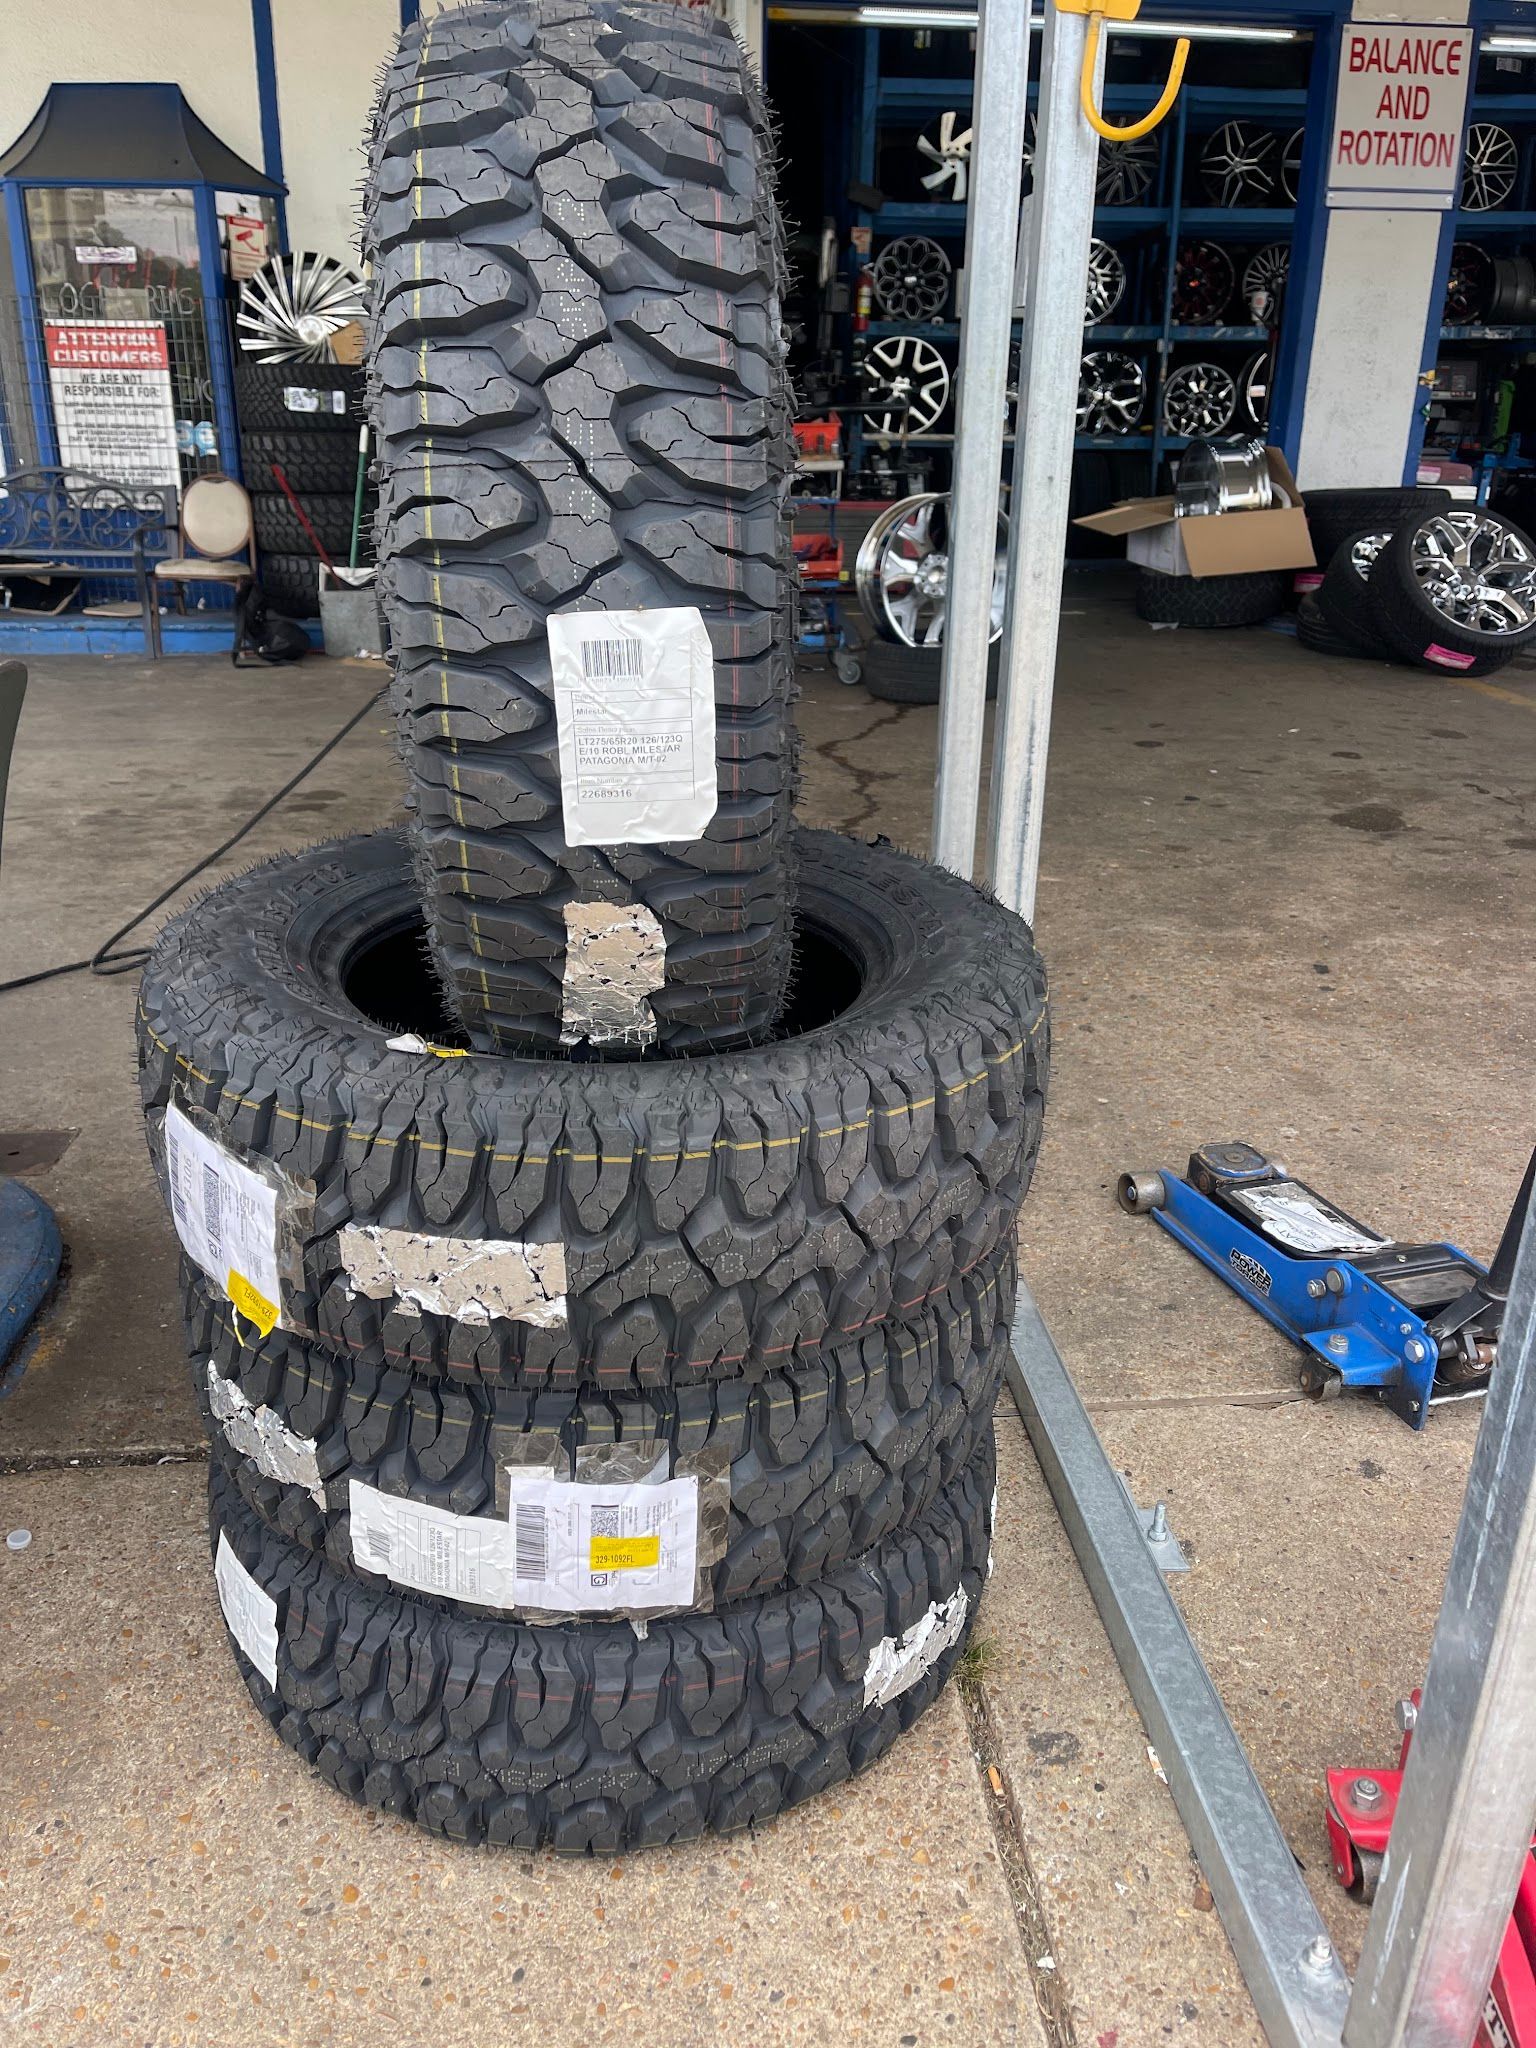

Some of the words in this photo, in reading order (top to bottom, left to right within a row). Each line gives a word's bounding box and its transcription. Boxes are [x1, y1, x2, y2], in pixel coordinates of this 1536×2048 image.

[1349, 37, 1463, 75] BALANCE
[1376, 85, 1431, 120] AND
[1337, 130, 1455, 168] ROTATION
[58, 331, 157, 346] ATTENTION
[53, 349, 163, 363] CUSTOMERS
[81, 373, 96, 384] WE
[100, 374, 119, 385] ARE
[122, 374, 143, 385] NOT
[64, 385, 135, 397] RESPONSIBLE
[578, 736, 638, 746] LT275/65R20
[641, 734, 683, 744] 126/123Q
[579, 747, 599, 755] E/10
[602, 746, 630, 755] ROBL
[579, 756, 635, 765] PATAGONIA
[637, 755, 667, 764] M/T-02
[582, 789, 632, 799] 22689316
[1231, 1249, 1271, 1289] POWER
[1231, 1259, 1269, 1295] TORQUE
[596, 1554, 635, 1564] 329-1092FL
